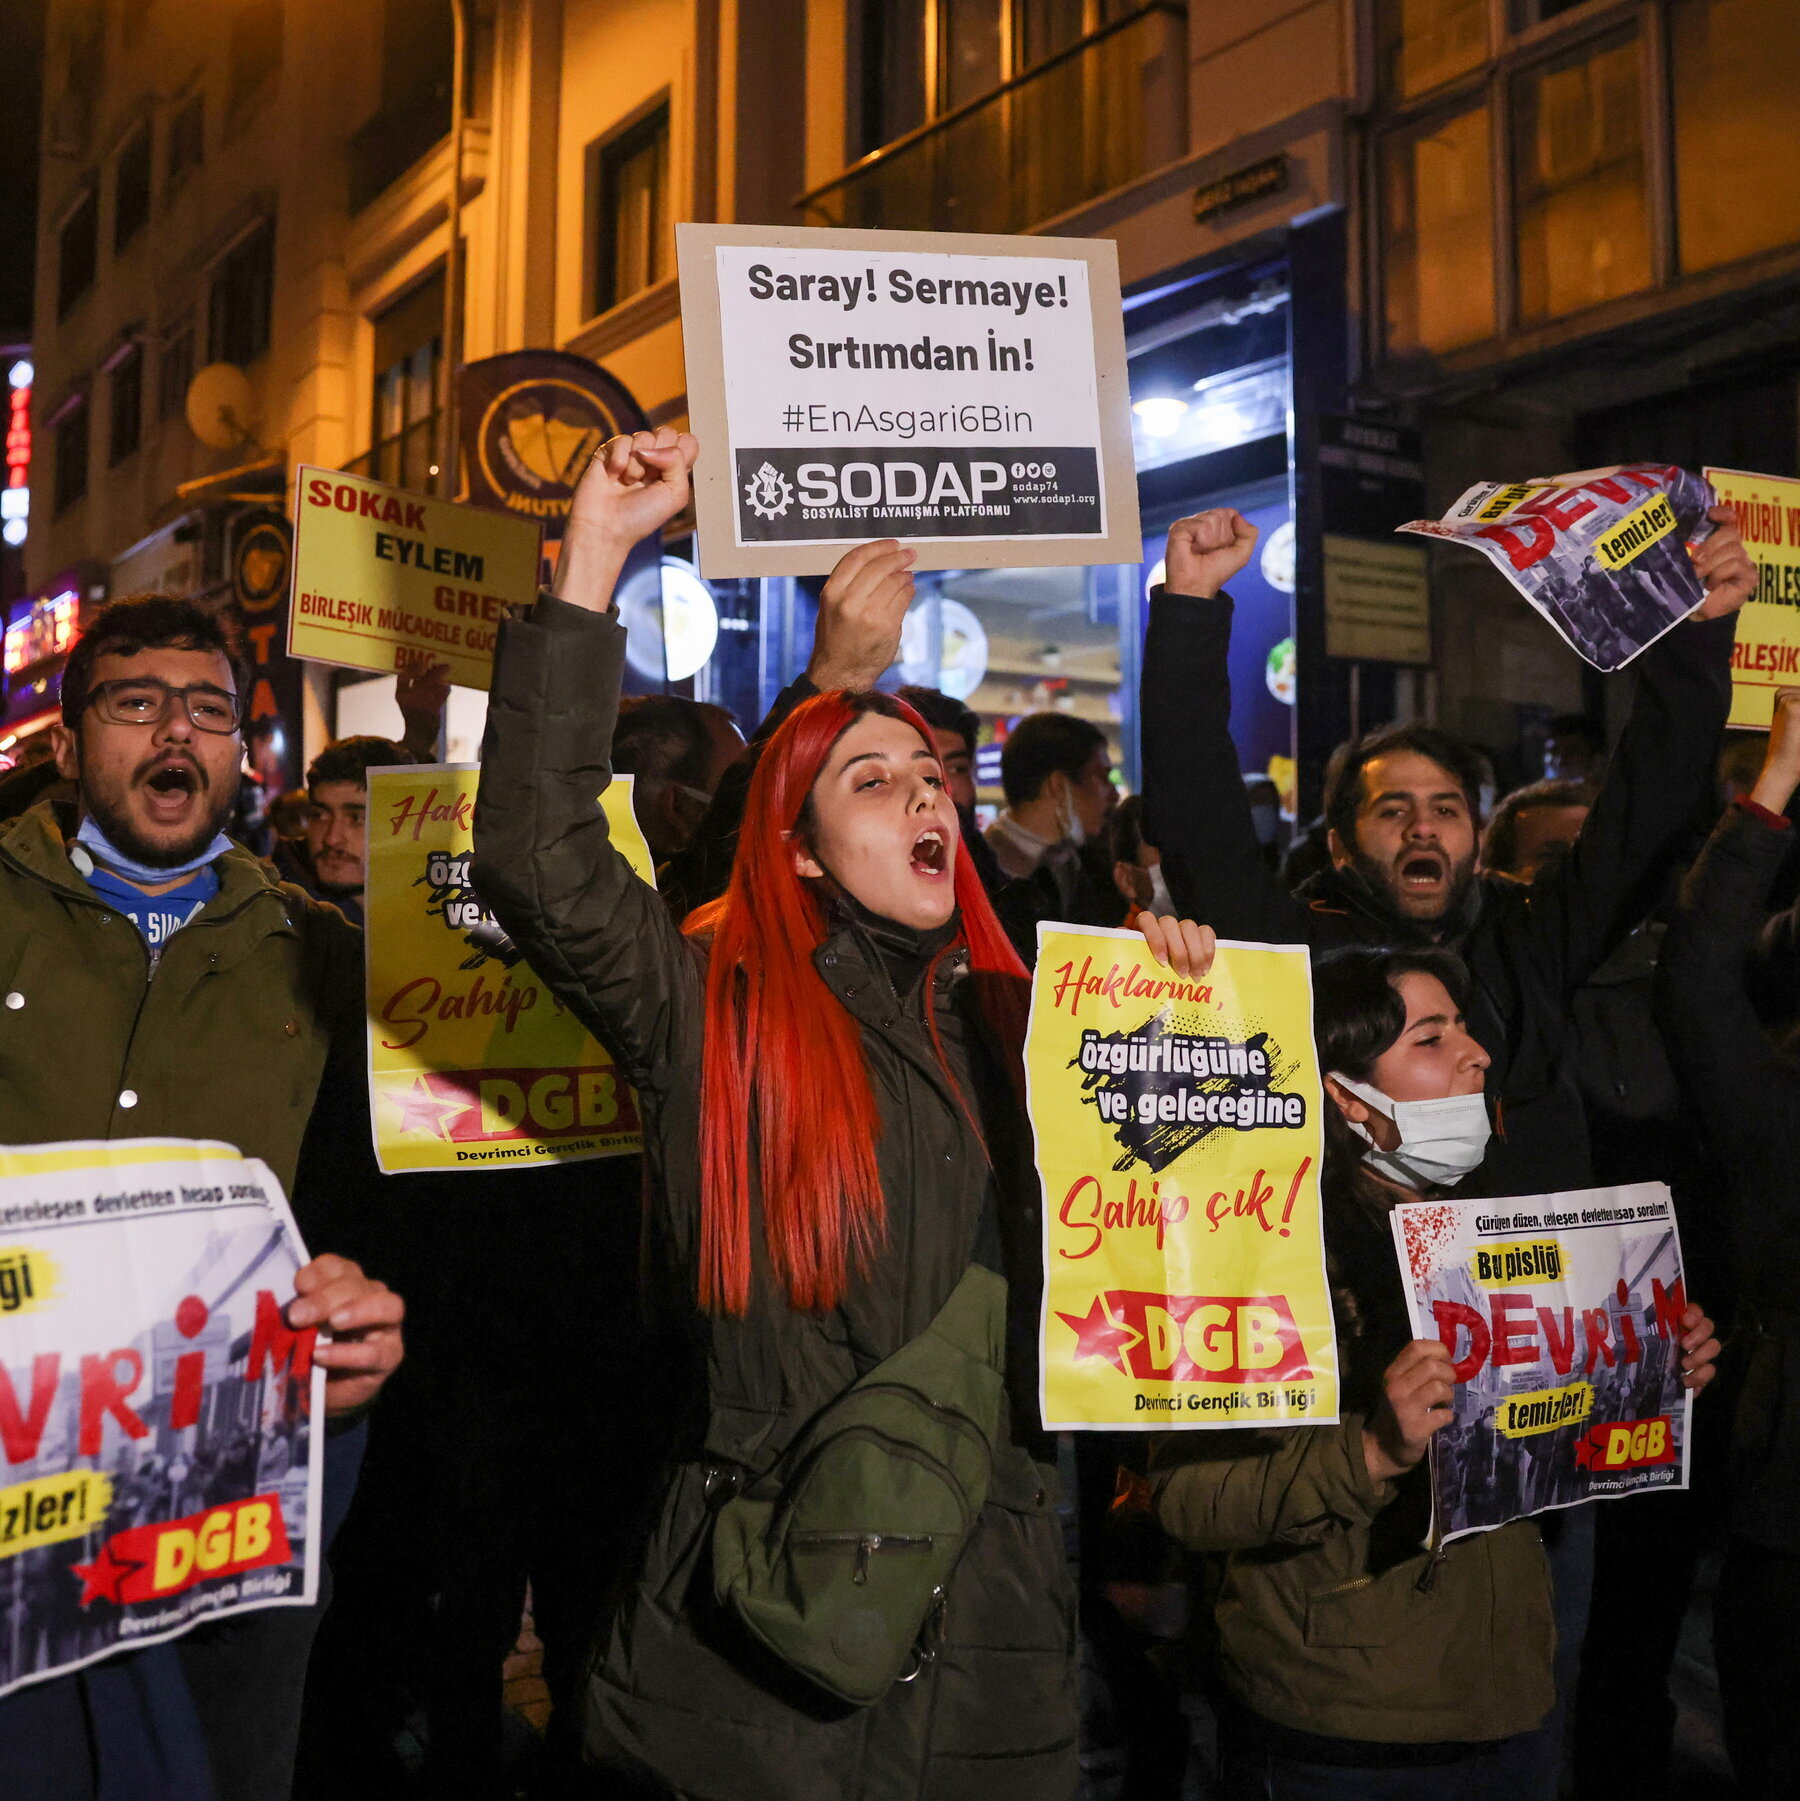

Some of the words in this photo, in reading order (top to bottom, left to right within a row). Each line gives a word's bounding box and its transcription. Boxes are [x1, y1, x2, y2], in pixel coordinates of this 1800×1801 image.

[748, 264, 876, 311] Saray!
[889, 268, 1069, 316] Sermaye!
[789, 333, 978, 371] Sırtımdan
[988, 328, 1035, 371] İn!
[782, 404, 1033, 439] #EnAsgari6Bin
[308, 479, 427, 532] SOKAK
[797, 461, 1007, 507] SODAP
[1012, 481, 1058, 493] sodap74
[1013, 493, 1096, 506] www.sodap1.org
[802, 505, 868, 520] SOSYALİST
[873, 505, 940, 520] DAYANIŞMA
[944, 504, 1011, 518] PLATFORMU
[375, 532, 484, 582] EYLEM
[300, 588, 373, 629] BİRLEŞİK
[377, 602, 461, 646] MÜCADELE
[434, 585, 508, 623] GRE
[446, 902, 480, 926] ve
[1053, 955, 1224, 1016] Haklarına,
[381, 975, 538, 1050] Sahip
[1081, 1033, 1267, 1078] özgürlüğüne
[479, 1072, 619, 1134] DGB
[1097, 1090, 1128, 1121] ve
[1138, 1087, 1303, 1127] geleceğine
[456, 1145, 531, 1162] Devrimci
[534, 1140, 596, 1156] Gençlik
[179, 1184, 225, 1206] hesap
[1058, 1175, 1190, 1259] Sahip
[1205, 1155, 1312, 1238] çık!
[1512, 1212, 1542, 1228] düzen,
[1637, 1201, 1669, 1218] soralım!
[1477, 1251, 1502, 1280] Bu
[1506, 1244, 1562, 1281] pisliği
[1143, 1303, 1285, 1372] DGB
[1134, 1393, 1182, 1411] Devrimci
[1187, 1391, 1252, 1415] Gençlik
[1257, 1388, 1316, 1412] Birliği
[1508, 1387, 1587, 1430] temizler!
[1605, 1420, 1666, 1466] DGB
[1649, 1469, 1675, 1483] Birliği
[0, 1479, 90, 1542] zler!
[153, 1502, 273, 1591] DGB
